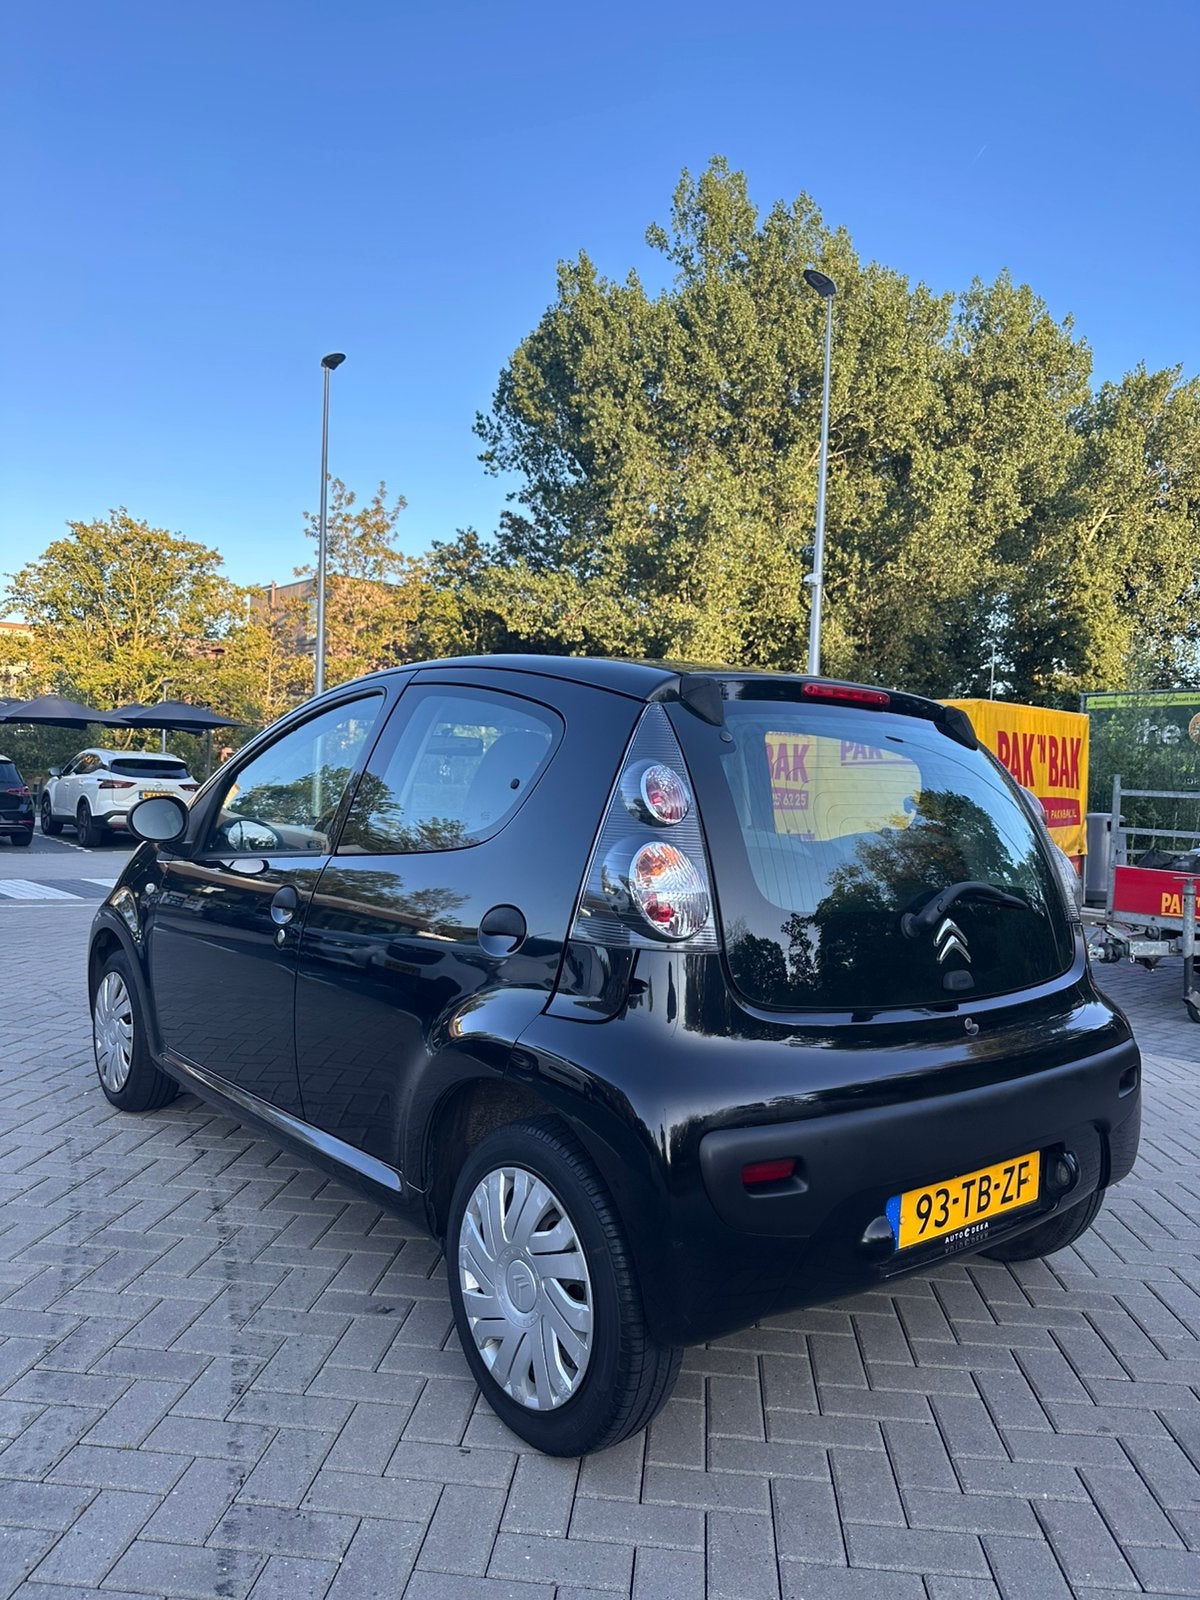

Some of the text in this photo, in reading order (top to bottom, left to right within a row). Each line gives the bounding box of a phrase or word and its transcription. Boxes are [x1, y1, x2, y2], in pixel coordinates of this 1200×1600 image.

[998, 730, 1036, 788] PAK
[1048, 735, 1082, 790] BAK
[794, 793, 807, 807] 25
[1161, 892, 1184, 914] PA
[916, 1160, 1030, 1235] 93-TB-ZF
